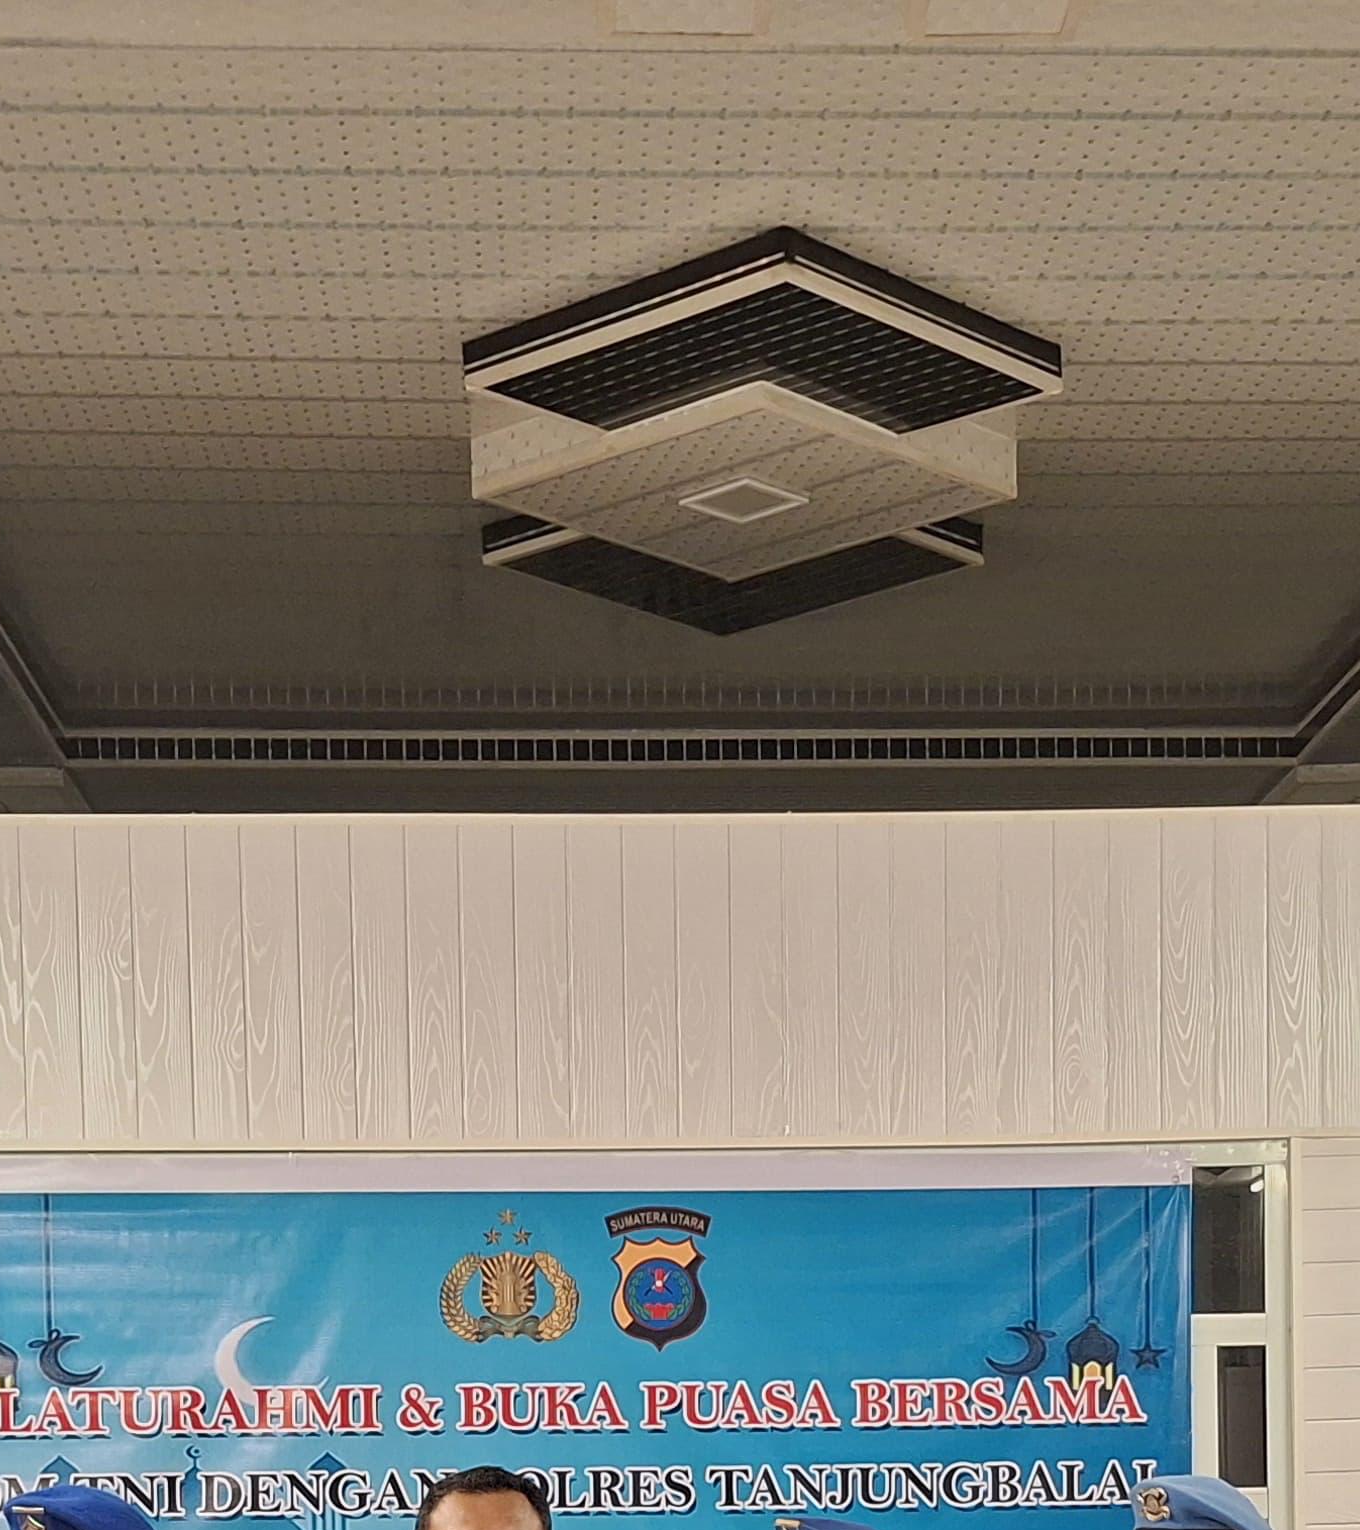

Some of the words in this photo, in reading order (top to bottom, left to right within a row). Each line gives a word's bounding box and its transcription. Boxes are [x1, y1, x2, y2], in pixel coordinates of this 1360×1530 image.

[609, 1210, 668, 1232] SUMATERA
[669, 1212, 705, 1232] UTARA
[397, 1384, 443, 1433] &
[455, 1382, 628, 1433] BUKA
[640, 1380, 839, 1430] PUASA
[852, 1375, 1147, 1427] BERSAMA
[514, 1465, 698, 1514] OLRES
